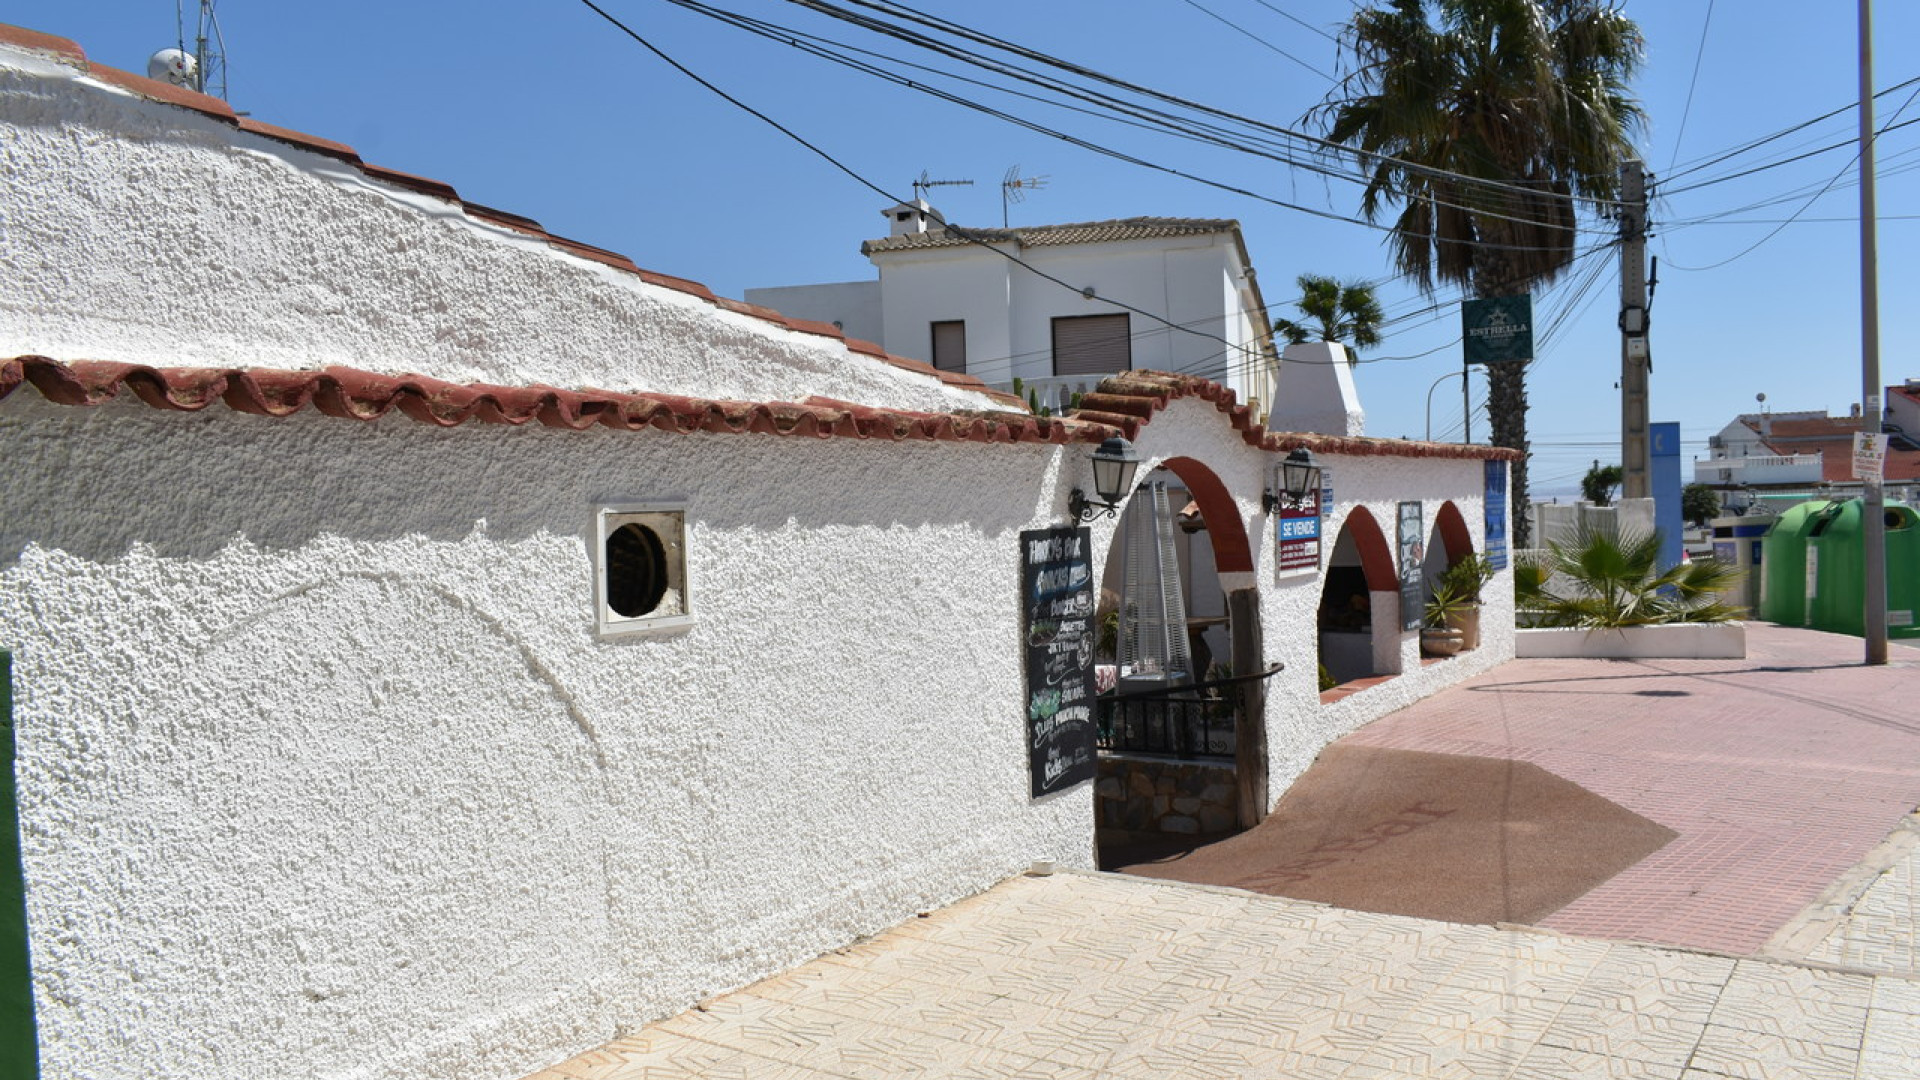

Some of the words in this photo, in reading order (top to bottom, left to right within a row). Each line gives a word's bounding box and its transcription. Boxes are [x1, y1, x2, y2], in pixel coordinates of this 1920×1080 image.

[1469, 324, 1527, 336] ESTRELLA
[1283, 523, 1292, 537] SE
[1293, 520, 1315, 535] VENDE
